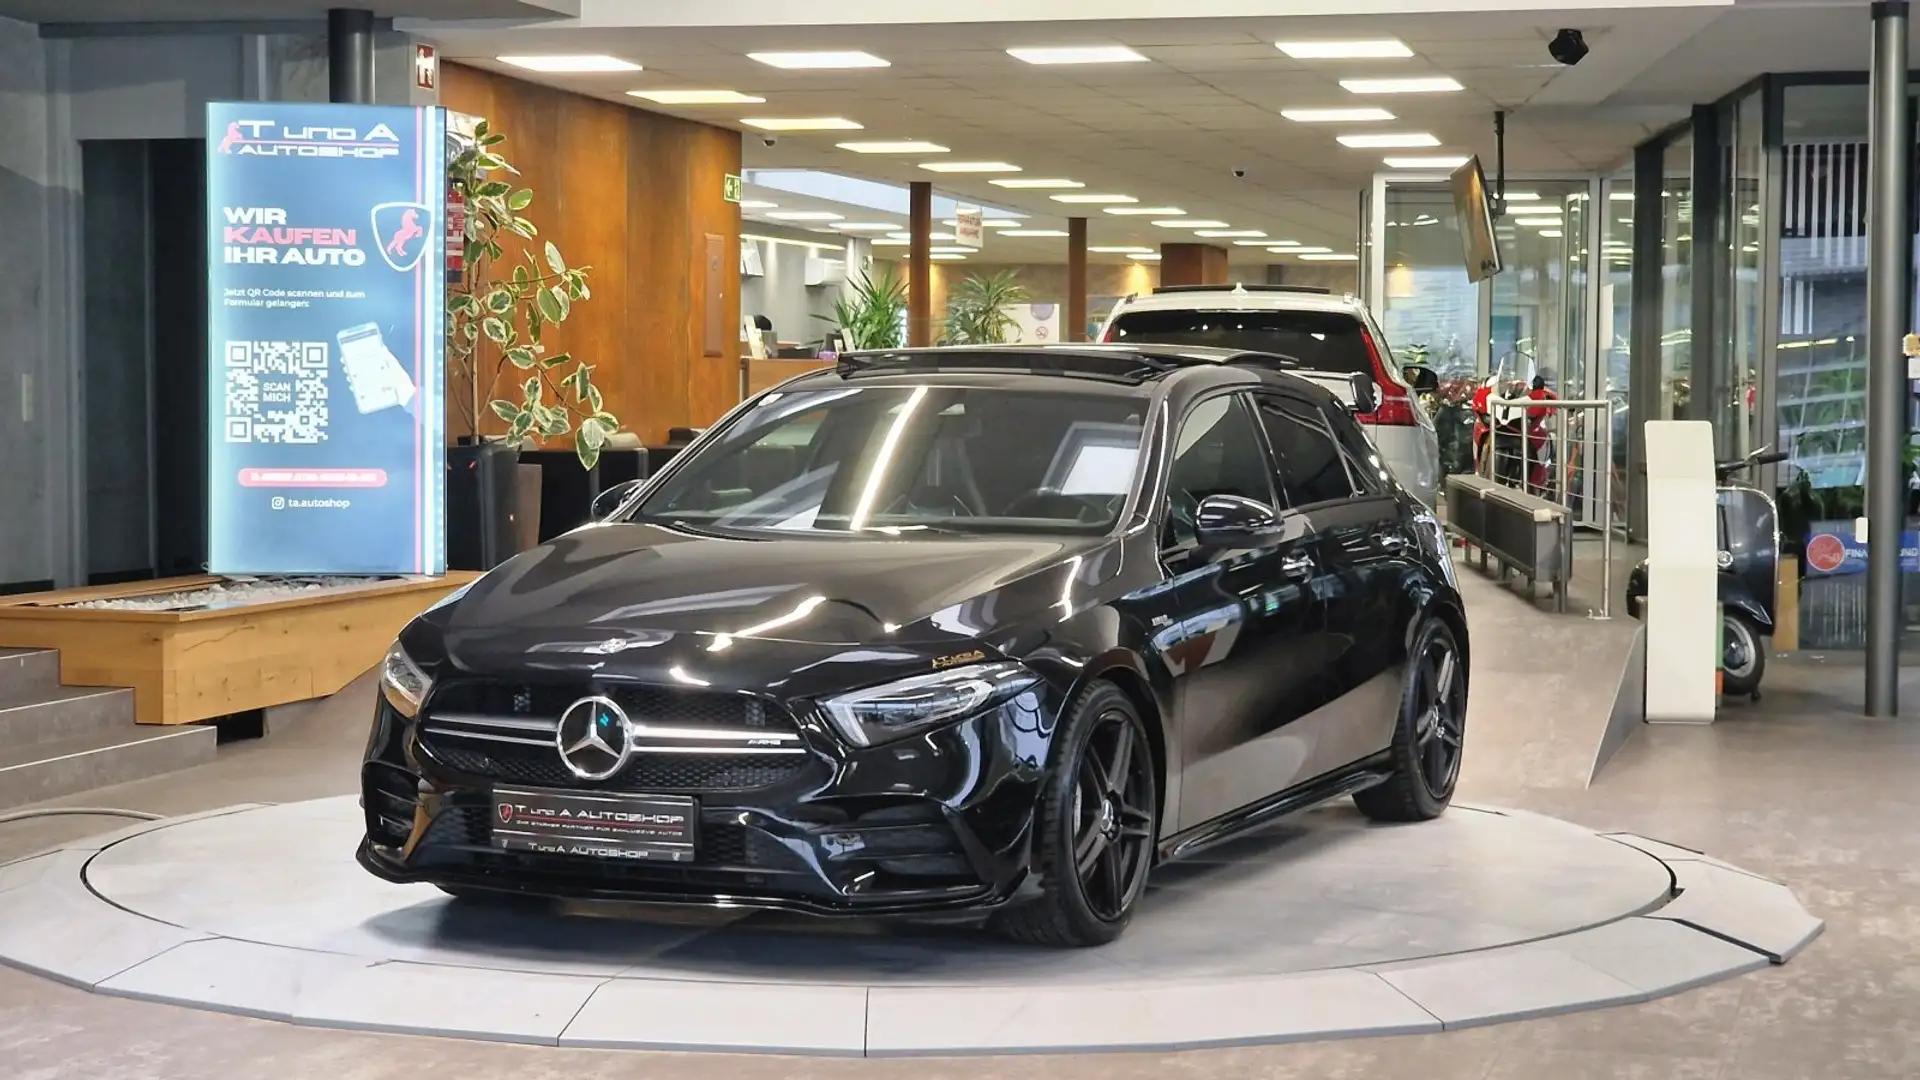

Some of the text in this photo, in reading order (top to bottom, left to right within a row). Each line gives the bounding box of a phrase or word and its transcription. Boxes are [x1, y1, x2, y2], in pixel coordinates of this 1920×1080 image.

[238, 120, 275, 138] T
[363, 123, 400, 141] A
[238, 144, 400, 159] AUTOSHOP
[223, 207, 287, 225] WIR
[223, 227, 357, 246] KAUFEN
[223, 247, 366, 266] IHR AUTO
[223, 288, 246, 298] Jetzt
[247, 288, 261, 298] QR
[262, 288, 286, 298] Code
[287, 289, 325, 299] scannen
[326, 289, 344, 299] und
[223, 299, 264, 308] Formular
[263, 382, 291, 393] SCAN
[263, 392, 291, 404] MICH
[288, 497, 351, 510] ta.autoshop
[515, 804, 528, 814] T
[559, 808, 572, 818] A
[577, 809, 684, 824] AUTOSHOP
[528, 842, 538, 850] T
[556, 844, 566, 853] A
[570, 845, 648, 859] AUTOSHOP
